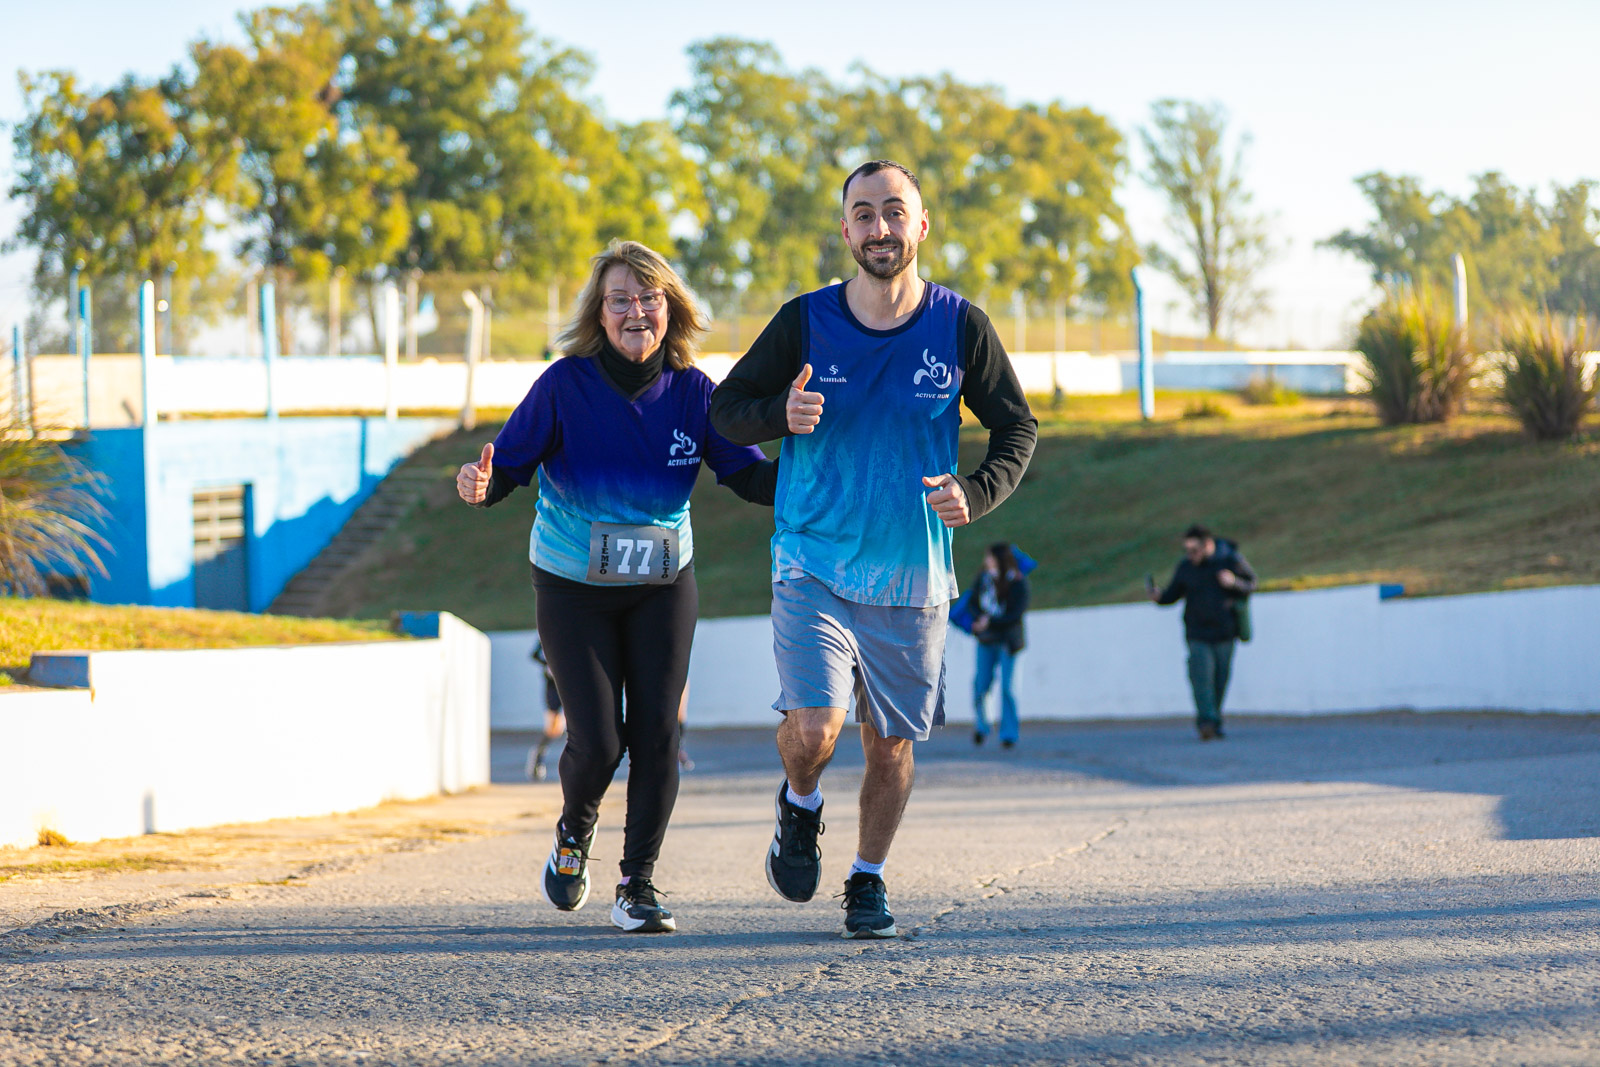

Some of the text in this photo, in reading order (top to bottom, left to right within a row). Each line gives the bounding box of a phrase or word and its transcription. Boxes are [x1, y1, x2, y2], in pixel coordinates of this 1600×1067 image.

[600, 534, 609, 575] TIEMPO
[616, 538, 654, 575] 77
[661, 539, 670, 579] EXACTO
